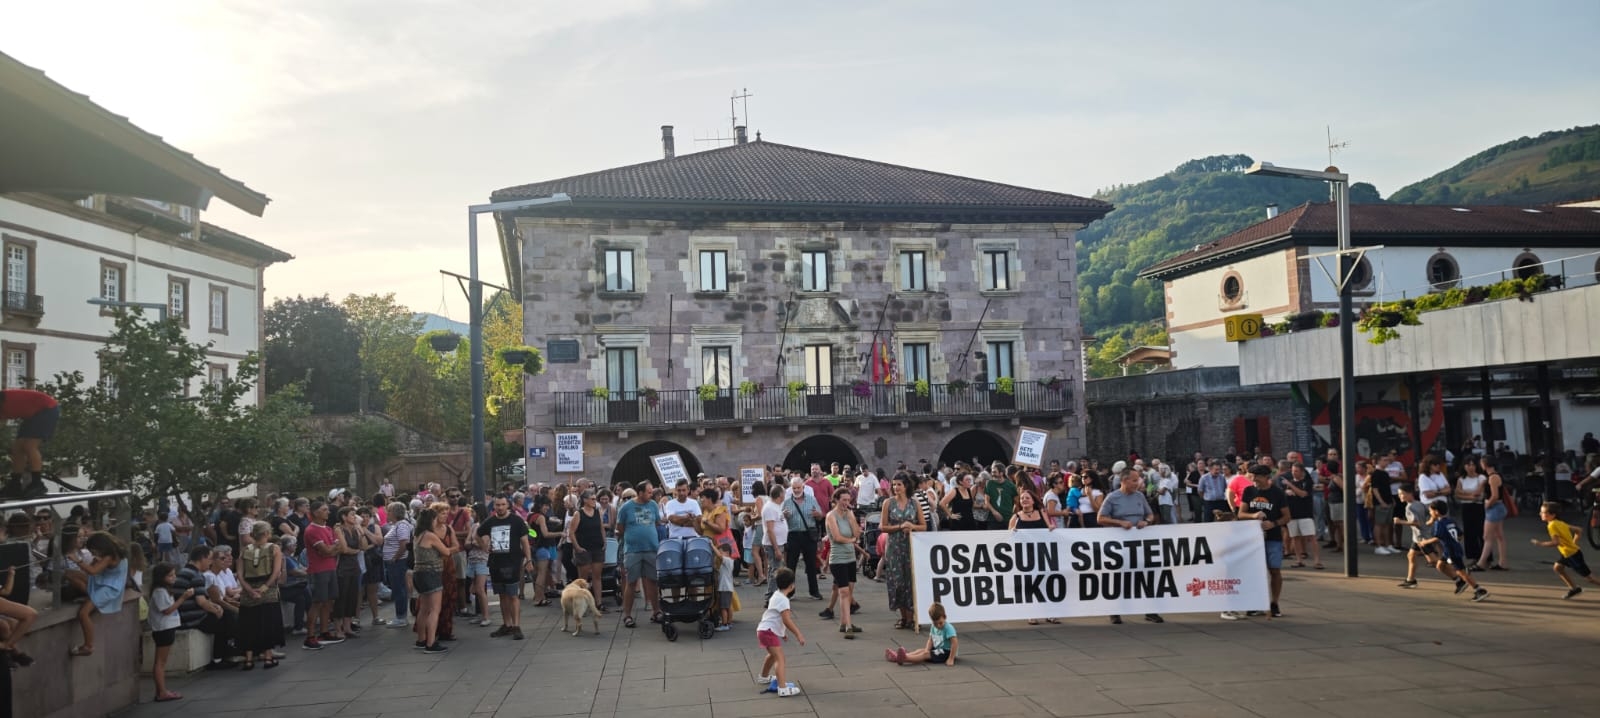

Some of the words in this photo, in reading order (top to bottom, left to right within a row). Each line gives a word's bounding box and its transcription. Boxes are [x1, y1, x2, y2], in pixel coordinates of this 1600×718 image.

[930, 542, 1059, 574] OSASUN
[1071, 536, 1214, 571] SISTEMA
[932, 573, 1067, 607] PUBLIKO
[1079, 569, 1179, 601] DUINA
